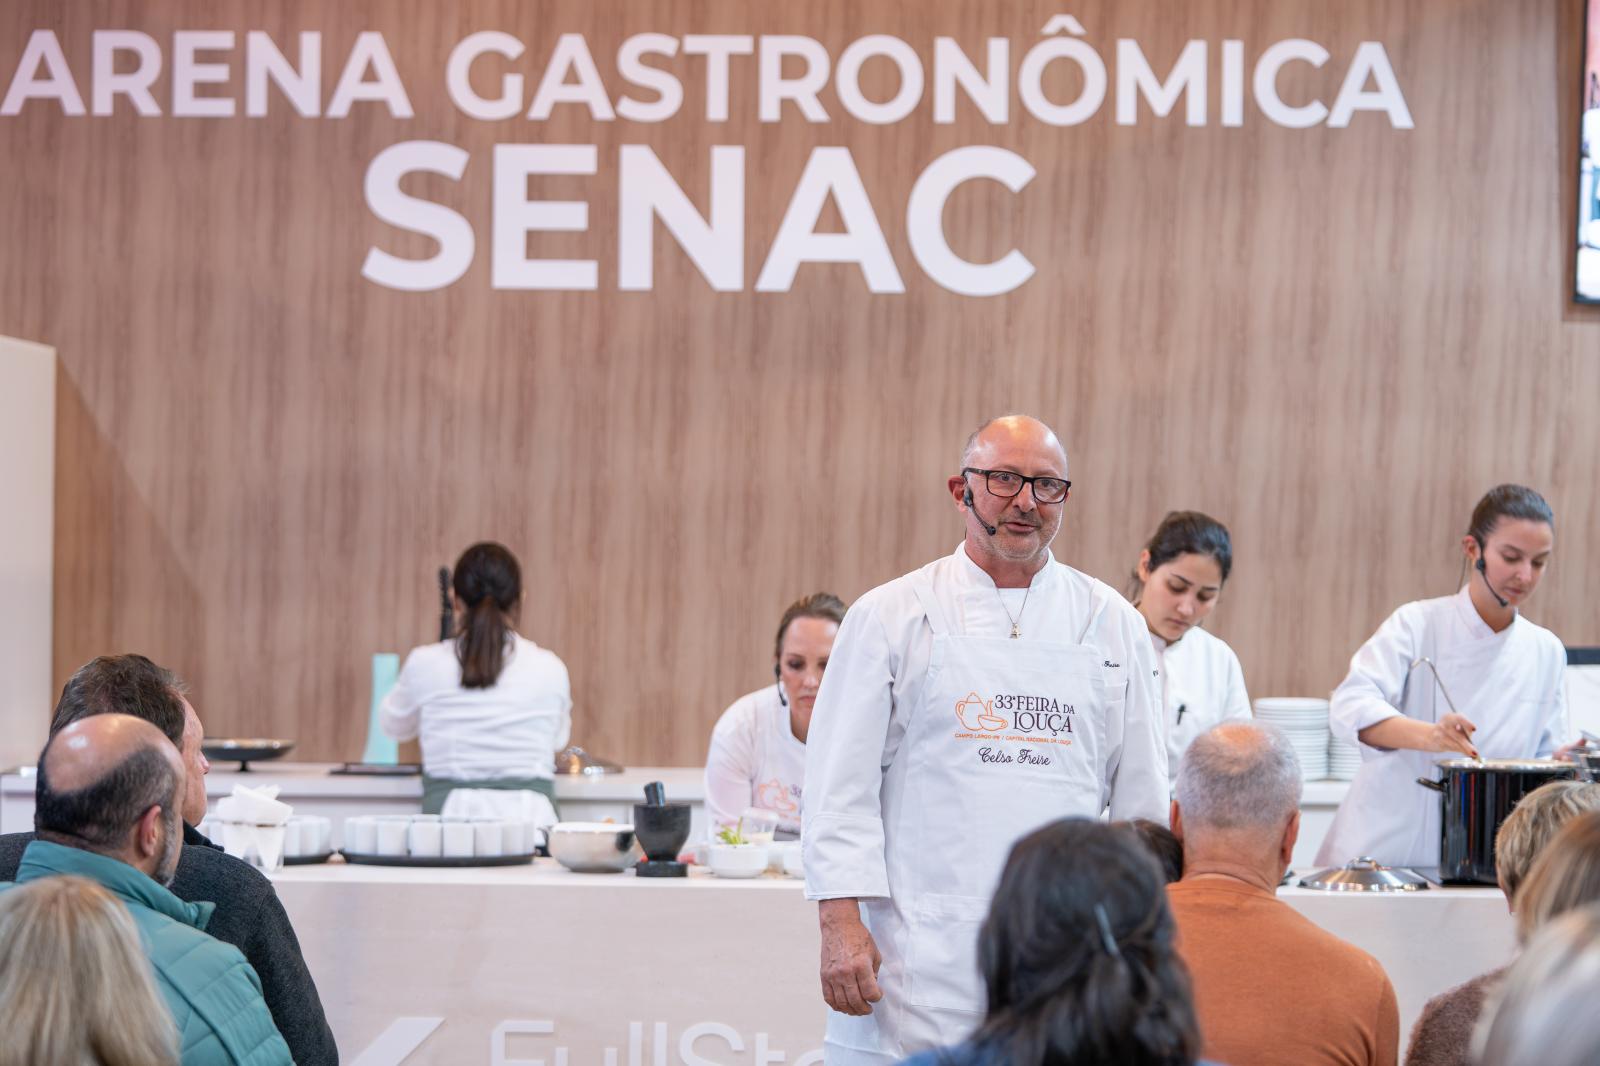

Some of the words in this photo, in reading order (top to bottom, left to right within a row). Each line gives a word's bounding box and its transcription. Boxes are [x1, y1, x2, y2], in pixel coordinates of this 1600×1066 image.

[0, 29, 414, 118] ARENA
[446, 14, 1414, 129] GASTRONÔMICA
[361, 140, 1037, 297] SENAC
[1016, 695, 1060, 712] FEIRA
[1063, 704, 1075, 714] DA
[1013, 712, 1072, 736] LOUÇA
[979, 747, 1013, 763] Celso
[1017, 749, 1051, 765] Freire
